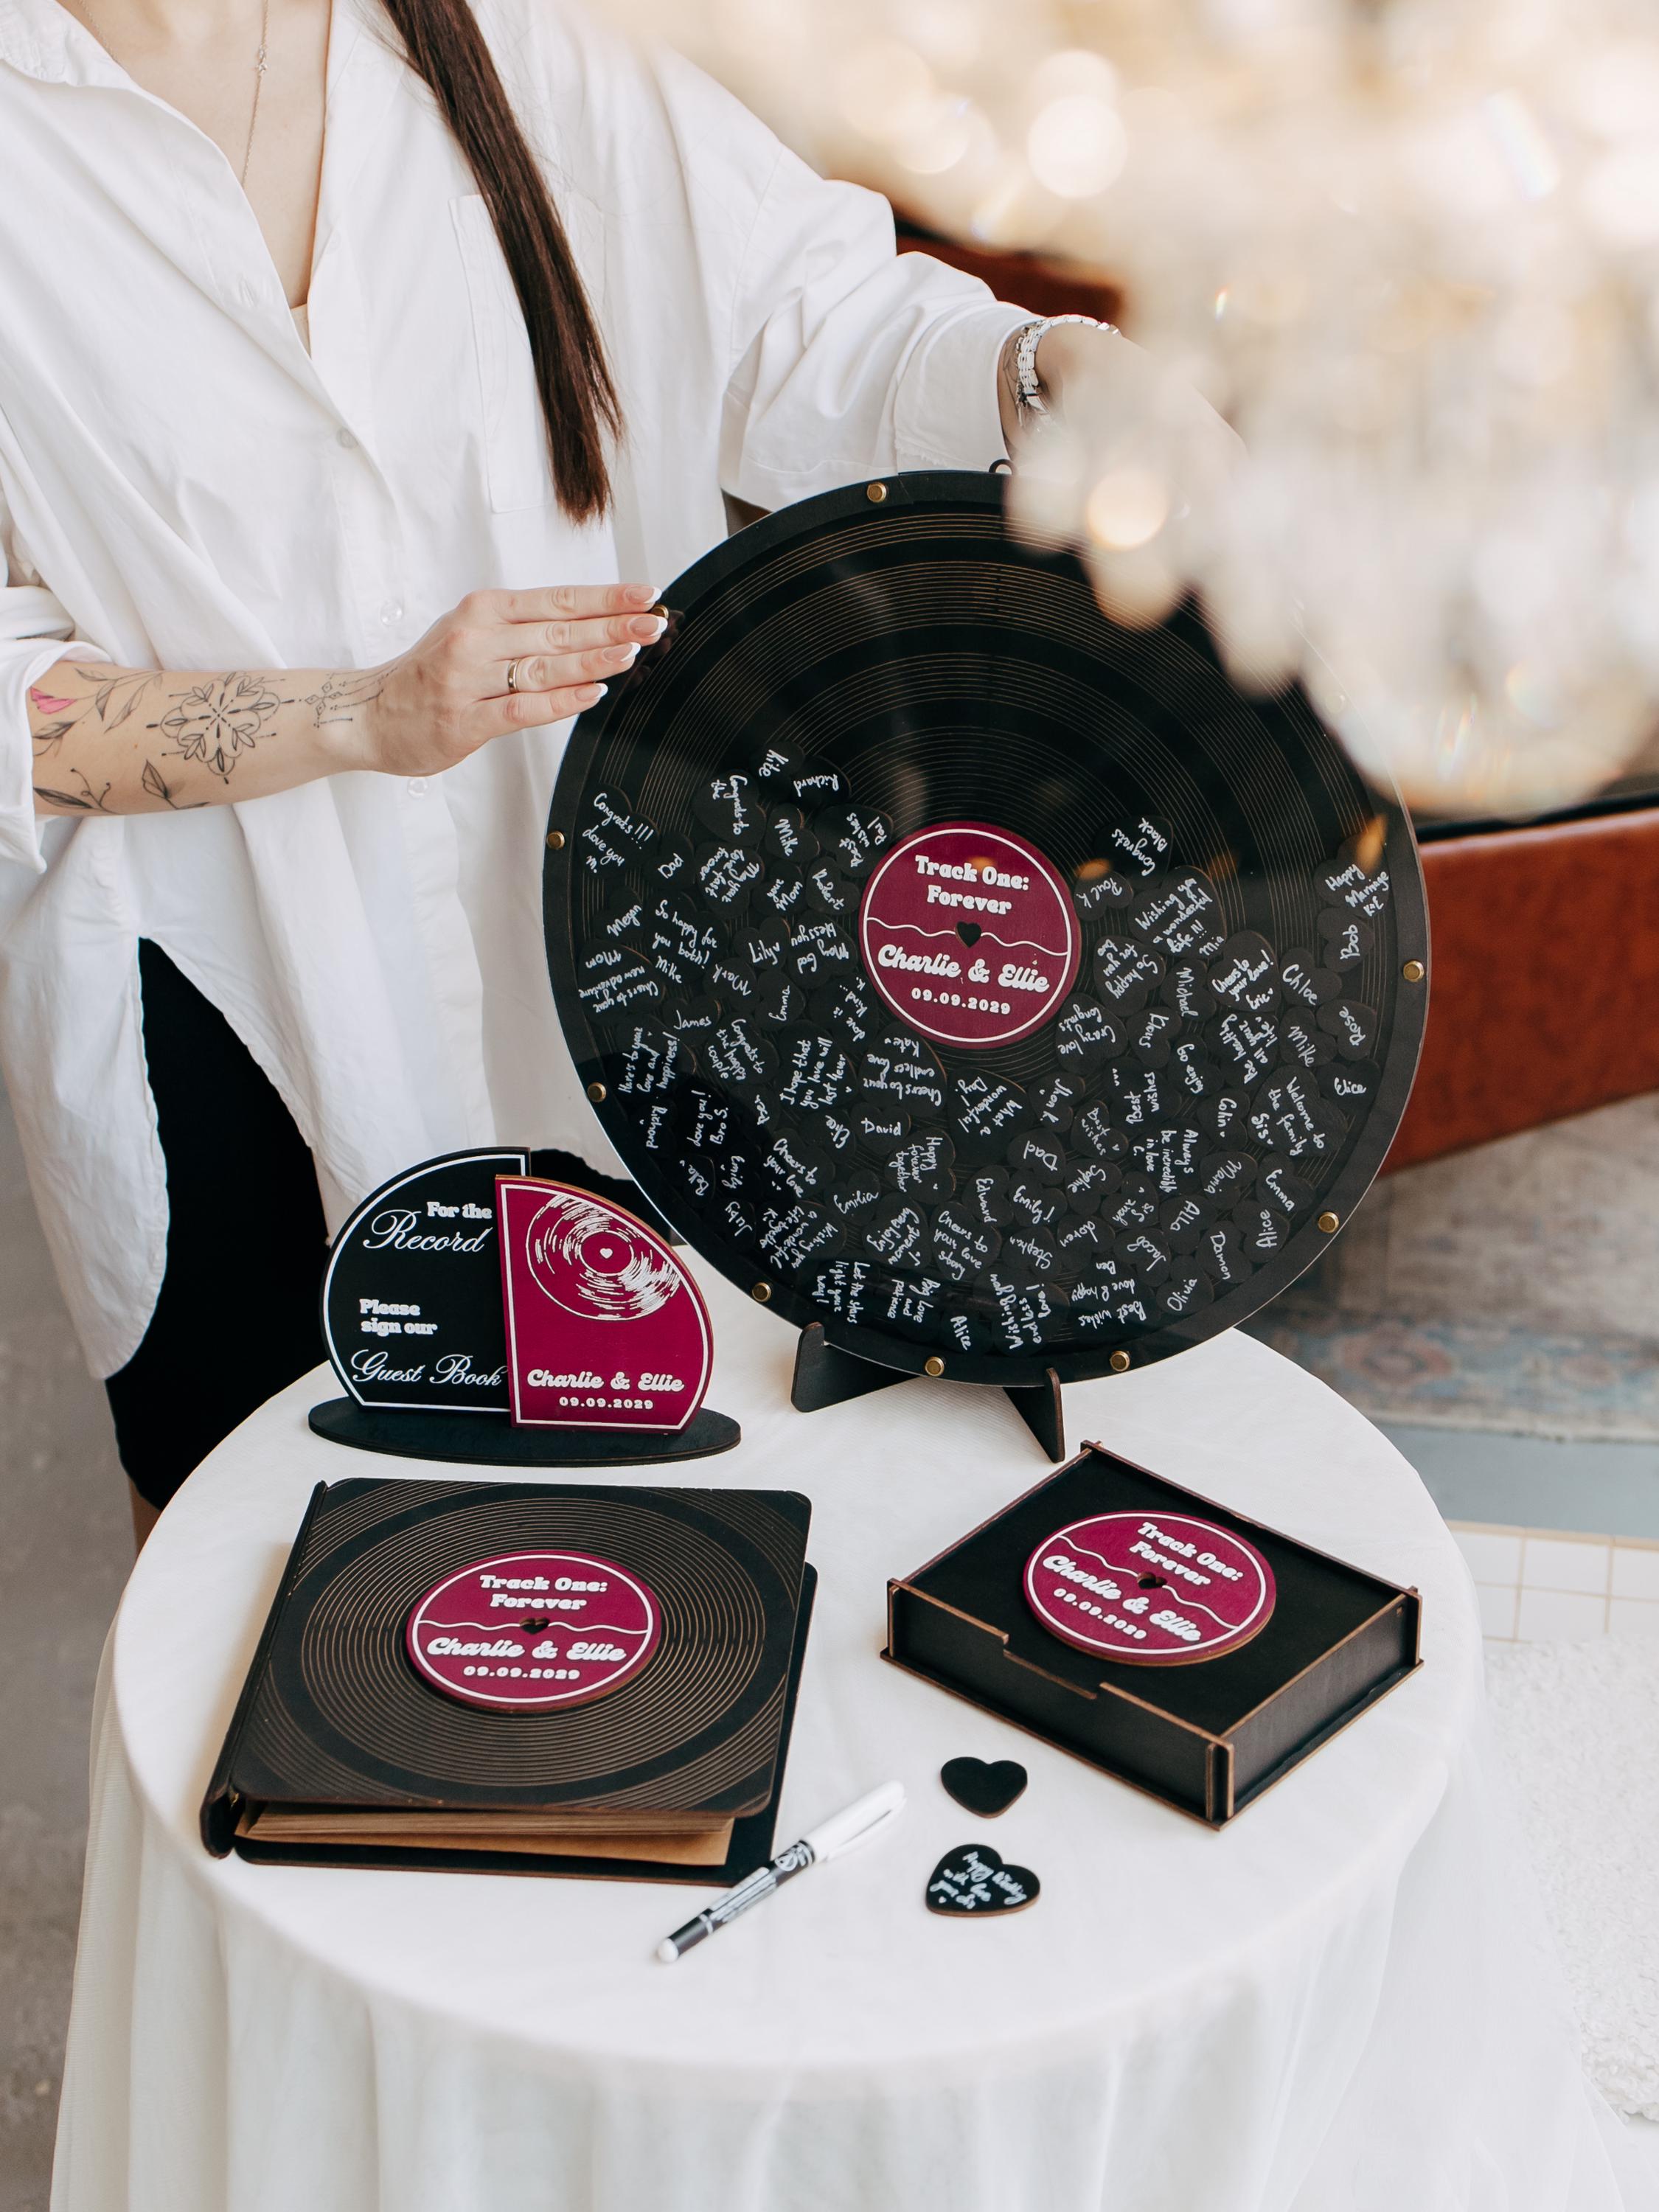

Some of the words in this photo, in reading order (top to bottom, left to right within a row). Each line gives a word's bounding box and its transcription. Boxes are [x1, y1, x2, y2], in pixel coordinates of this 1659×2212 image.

[793, 773, 838, 797] Richard
[775, 818, 799, 856] Mike
[658, 853, 684, 879] Dad
[914, 855, 978, 883] Track
[981, 866, 1030, 891] One:
[927, 884, 1013, 915] Forever
[877, 944, 961, 979] Charlie
[967, 958, 990, 984] &
[997, 963, 1050, 993] Ellie
[1282, 964, 1318, 1006] Chloe
[911, 987, 1011, 1015] 09.09.2029
[673, 1009, 712, 1030] James
[861, 1117, 901, 1136] David
[1023, 1140, 1058, 1172] Dad
[427, 1201, 459, 1218] For
[462, 1203, 493, 1220] the
[362, 1208, 493, 1253] Record
[1256, 1209, 1278, 1248] Alice
[1209, 1231, 1231, 1280] Damon
[358, 1298, 421, 1316] Please
[361, 1318, 402, 1337] sign
[403, 1322, 438, 1335] our
[350, 1349, 425, 1382] Guest
[429, 1354, 509, 1387] Book
[526, 1368, 605, 1389] Charlie
[610, 1371, 630, 1391] &
[637, 1372, 685, 1392] Ellie
[559, 1397, 654, 1410] 09.09.2029
[1128, 1540, 1212, 1587] Forever
[1137, 1520, 1198, 1559] Track
[1196, 1552, 1244, 1582] One:
[479, 1574, 550, 1590] Track
[554, 1576, 608, 1593] One:
[490, 1593, 587, 1610] Forever
[1043, 1554, 1123, 1600] Charlie
[1122, 1596, 1150, 1615] &
[1149, 1610, 1202, 1642] Ellie
[426, 1637, 526, 1658] Charlie
[531, 1640, 558, 1659] &
[566, 1641, 627, 1662] Ellie
[463, 1666, 580, 1680] 09.09.2029
